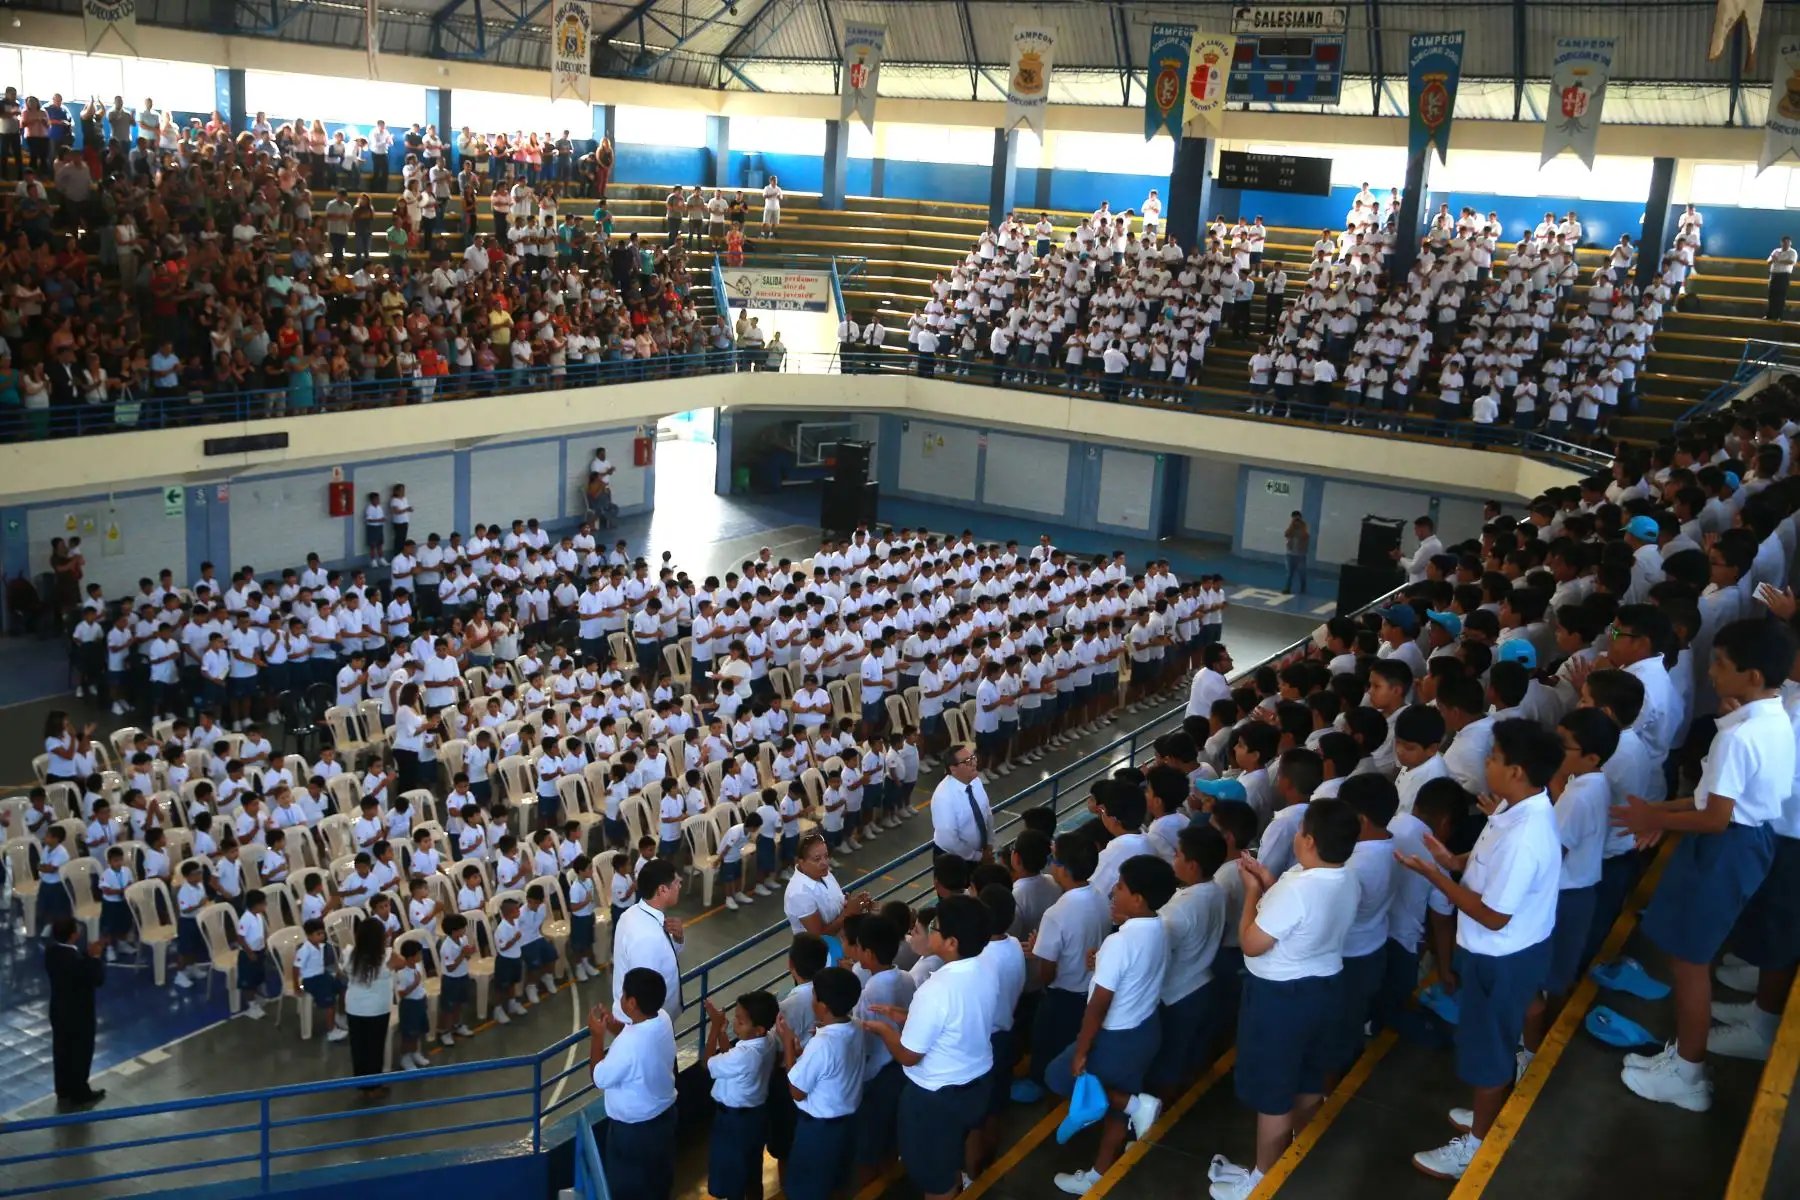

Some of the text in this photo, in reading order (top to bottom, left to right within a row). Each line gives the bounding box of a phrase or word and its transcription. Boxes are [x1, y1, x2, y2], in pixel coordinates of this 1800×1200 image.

[1254, 10, 1323, 28] SALESIANO
[1014, 31, 1054, 46] CAMPEON
[1411, 34, 1462, 47] CAMPEON
[1557, 39, 1615, 49] CAMPEON
[1554, 51, 1600, 66] ADECORE
[556, 60, 588, 75] ADECORE
[1765, 120, 1800, 136] ADECO
[762, 275, 783, 286] SALIDA
[747, 299, 772, 309] INCA
[775, 300, 805, 311] KOLA
[1273, 481, 1290, 494] SALIDA
